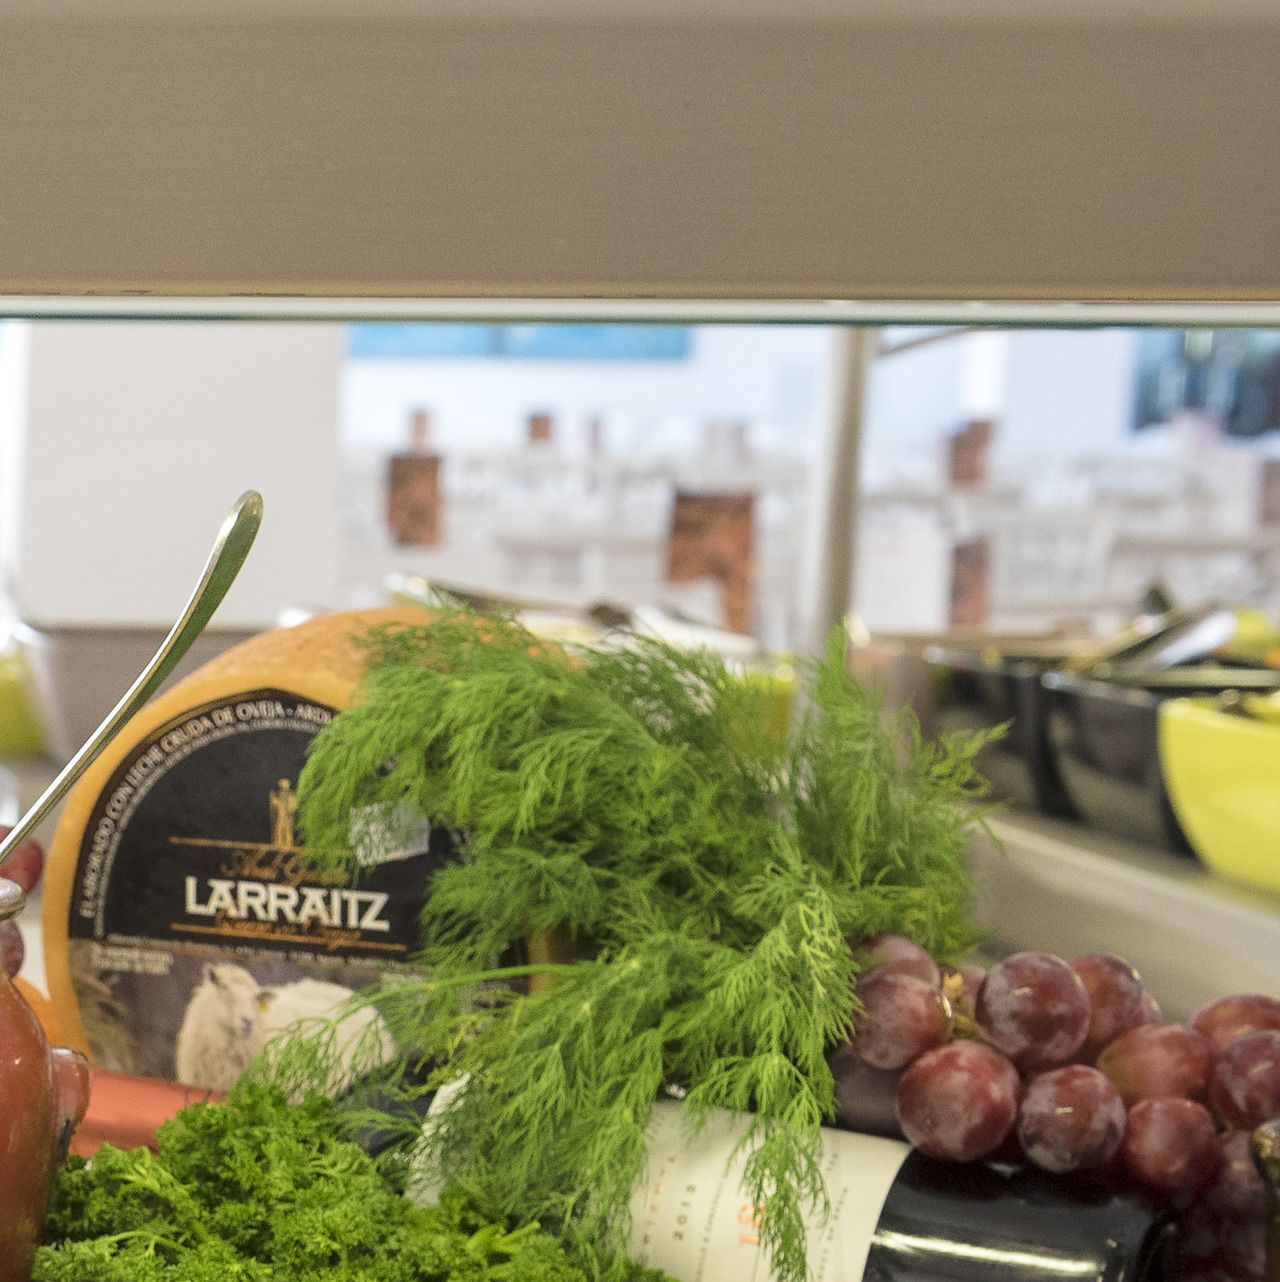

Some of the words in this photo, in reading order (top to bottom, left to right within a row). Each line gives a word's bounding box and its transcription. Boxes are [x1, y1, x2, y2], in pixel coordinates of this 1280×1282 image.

[105, 781, 135, 820] CON
[160, 715, 215, 752] CRUDA
[184, 876, 390, 932] LARRAITZ
